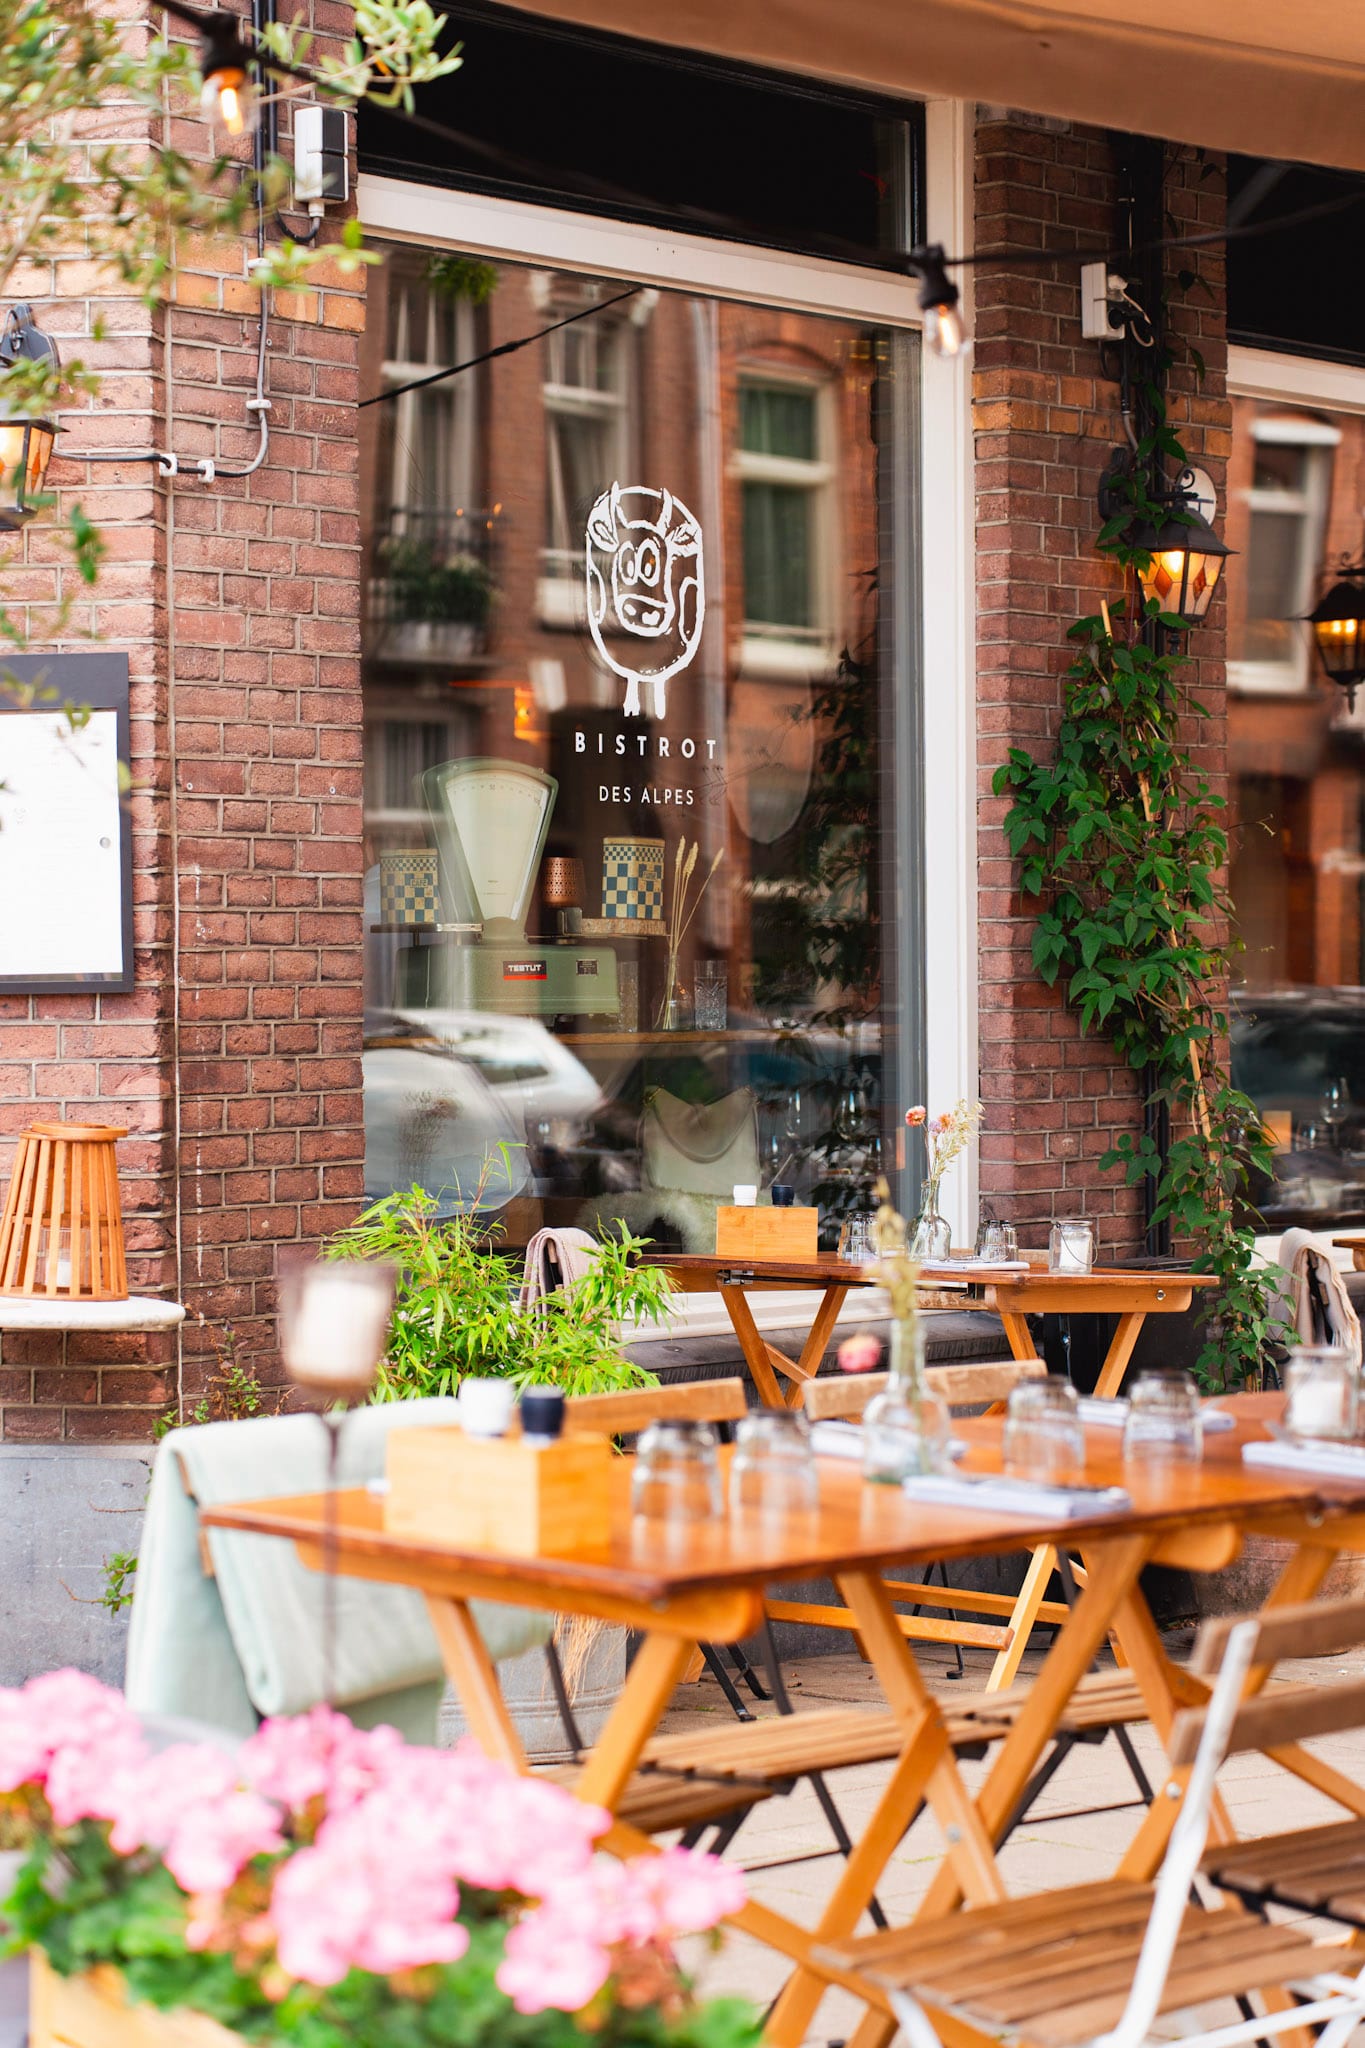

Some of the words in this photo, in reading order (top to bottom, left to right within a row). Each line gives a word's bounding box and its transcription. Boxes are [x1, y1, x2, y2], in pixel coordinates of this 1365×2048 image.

[575, 731, 716, 759] BISTROT
[599, 786, 631, 802] DES
[641, 787, 694, 805] ALPES
